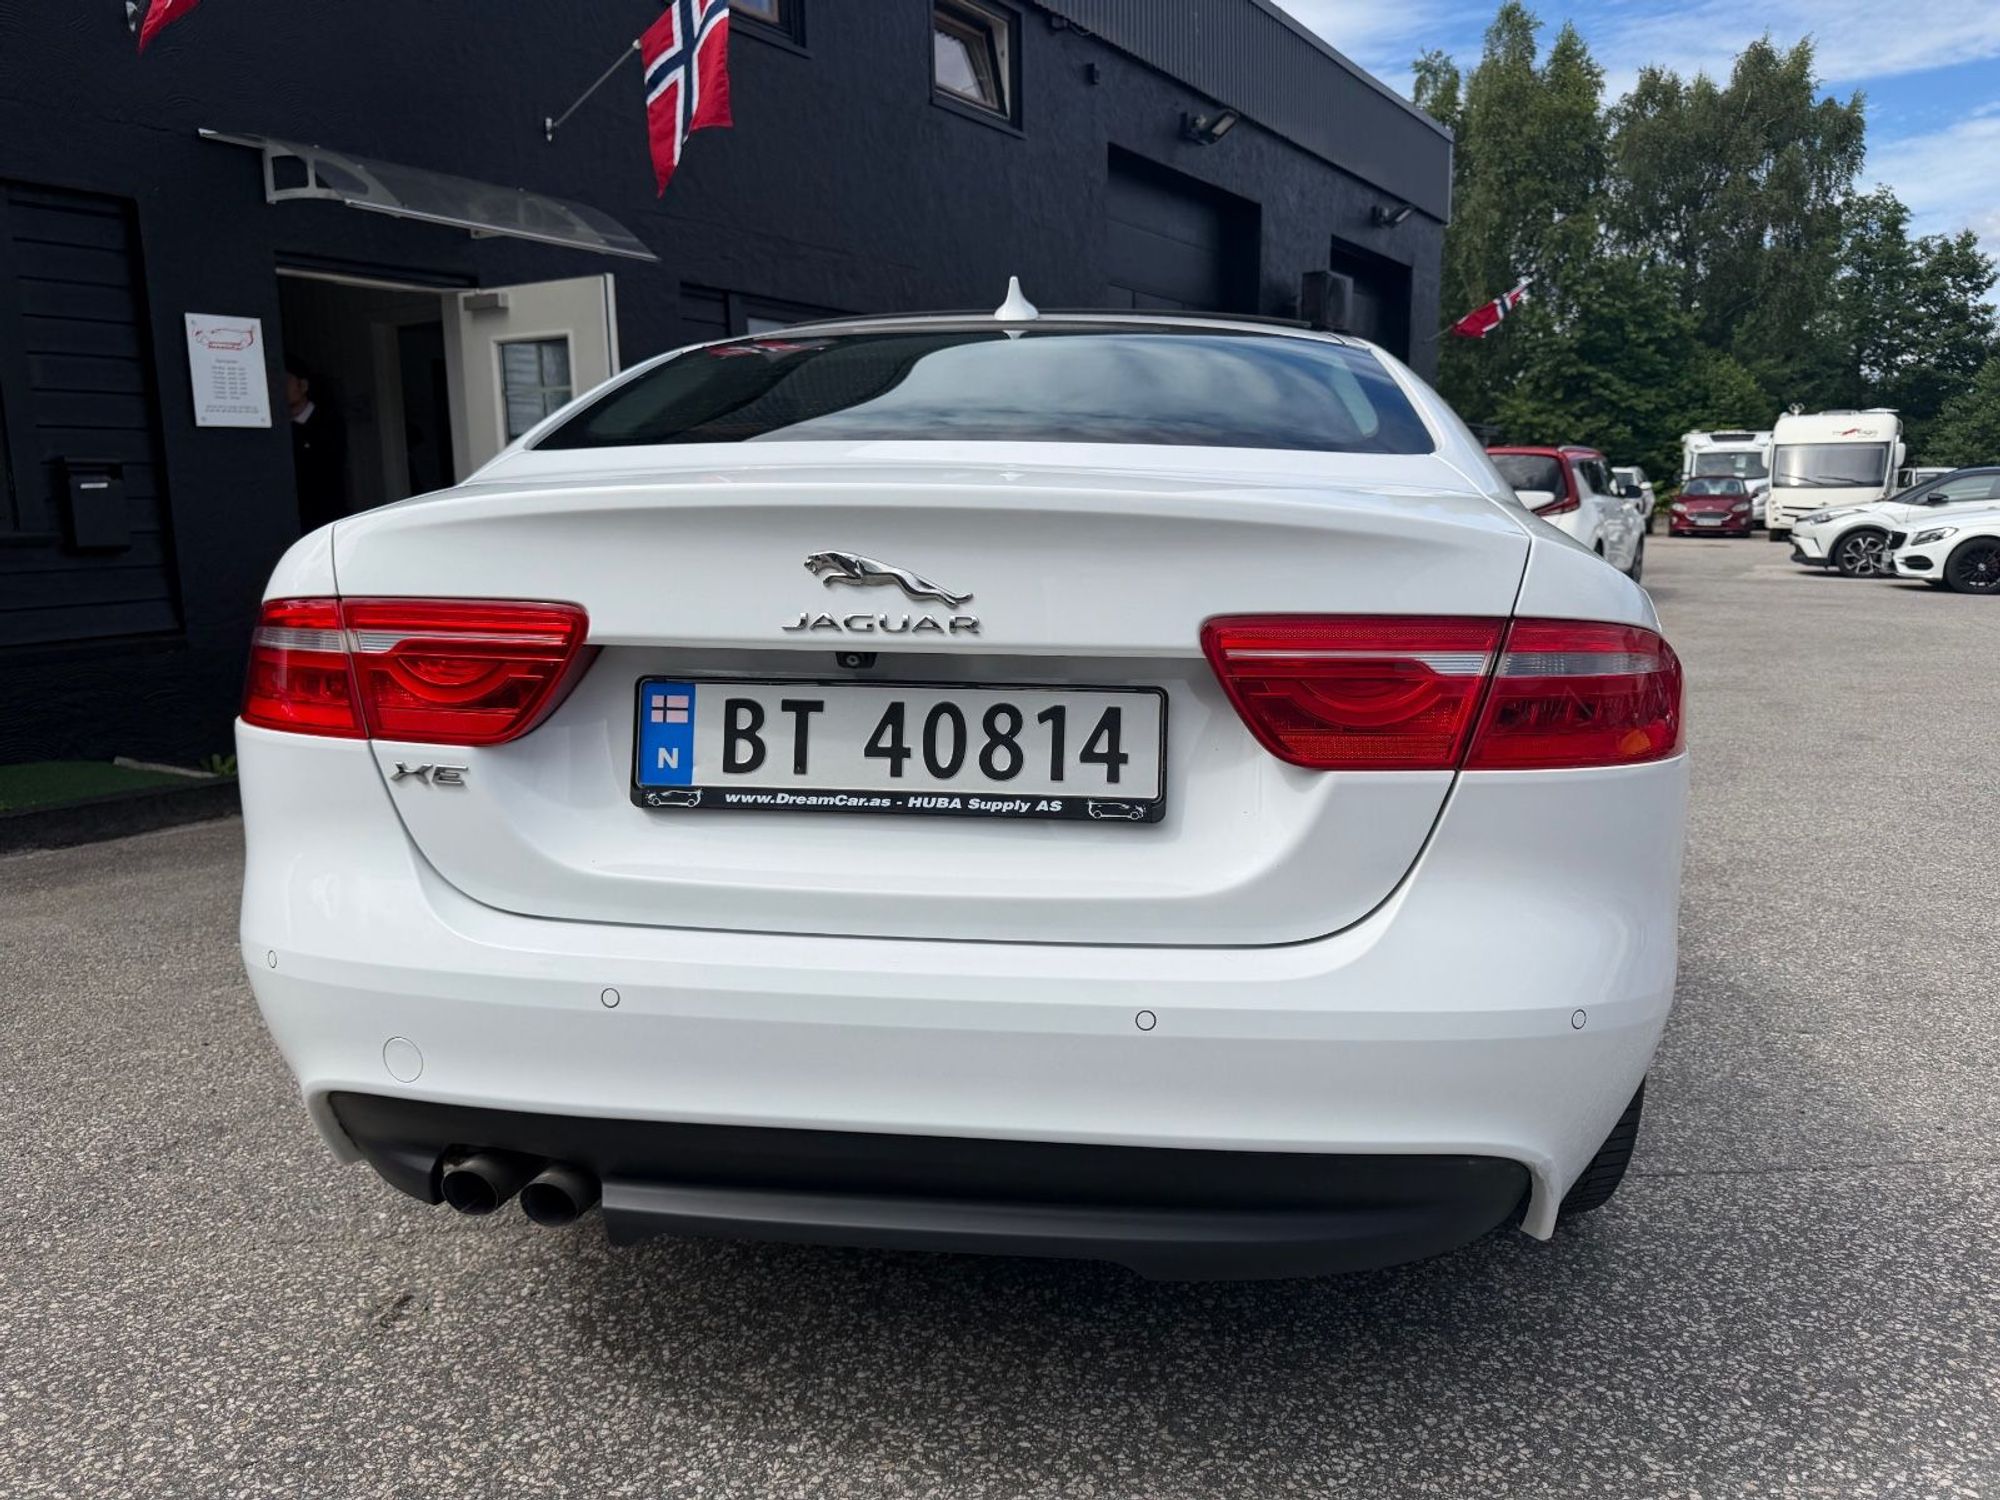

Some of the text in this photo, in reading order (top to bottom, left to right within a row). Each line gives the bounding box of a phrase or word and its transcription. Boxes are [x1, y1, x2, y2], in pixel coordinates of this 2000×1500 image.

[781, 612, 981, 635] JAGUAR
[722, 697, 1129, 784] BT 40814
[657, 747, 679, 769] N
[390, 761, 469, 786] XE
[725, 793, 891, 807] www.DreamCar.as
[907, 796, 962, 809] HUBA
[967, 798, 1031, 812] Supply
[1035, 800, 1063, 811] AS
